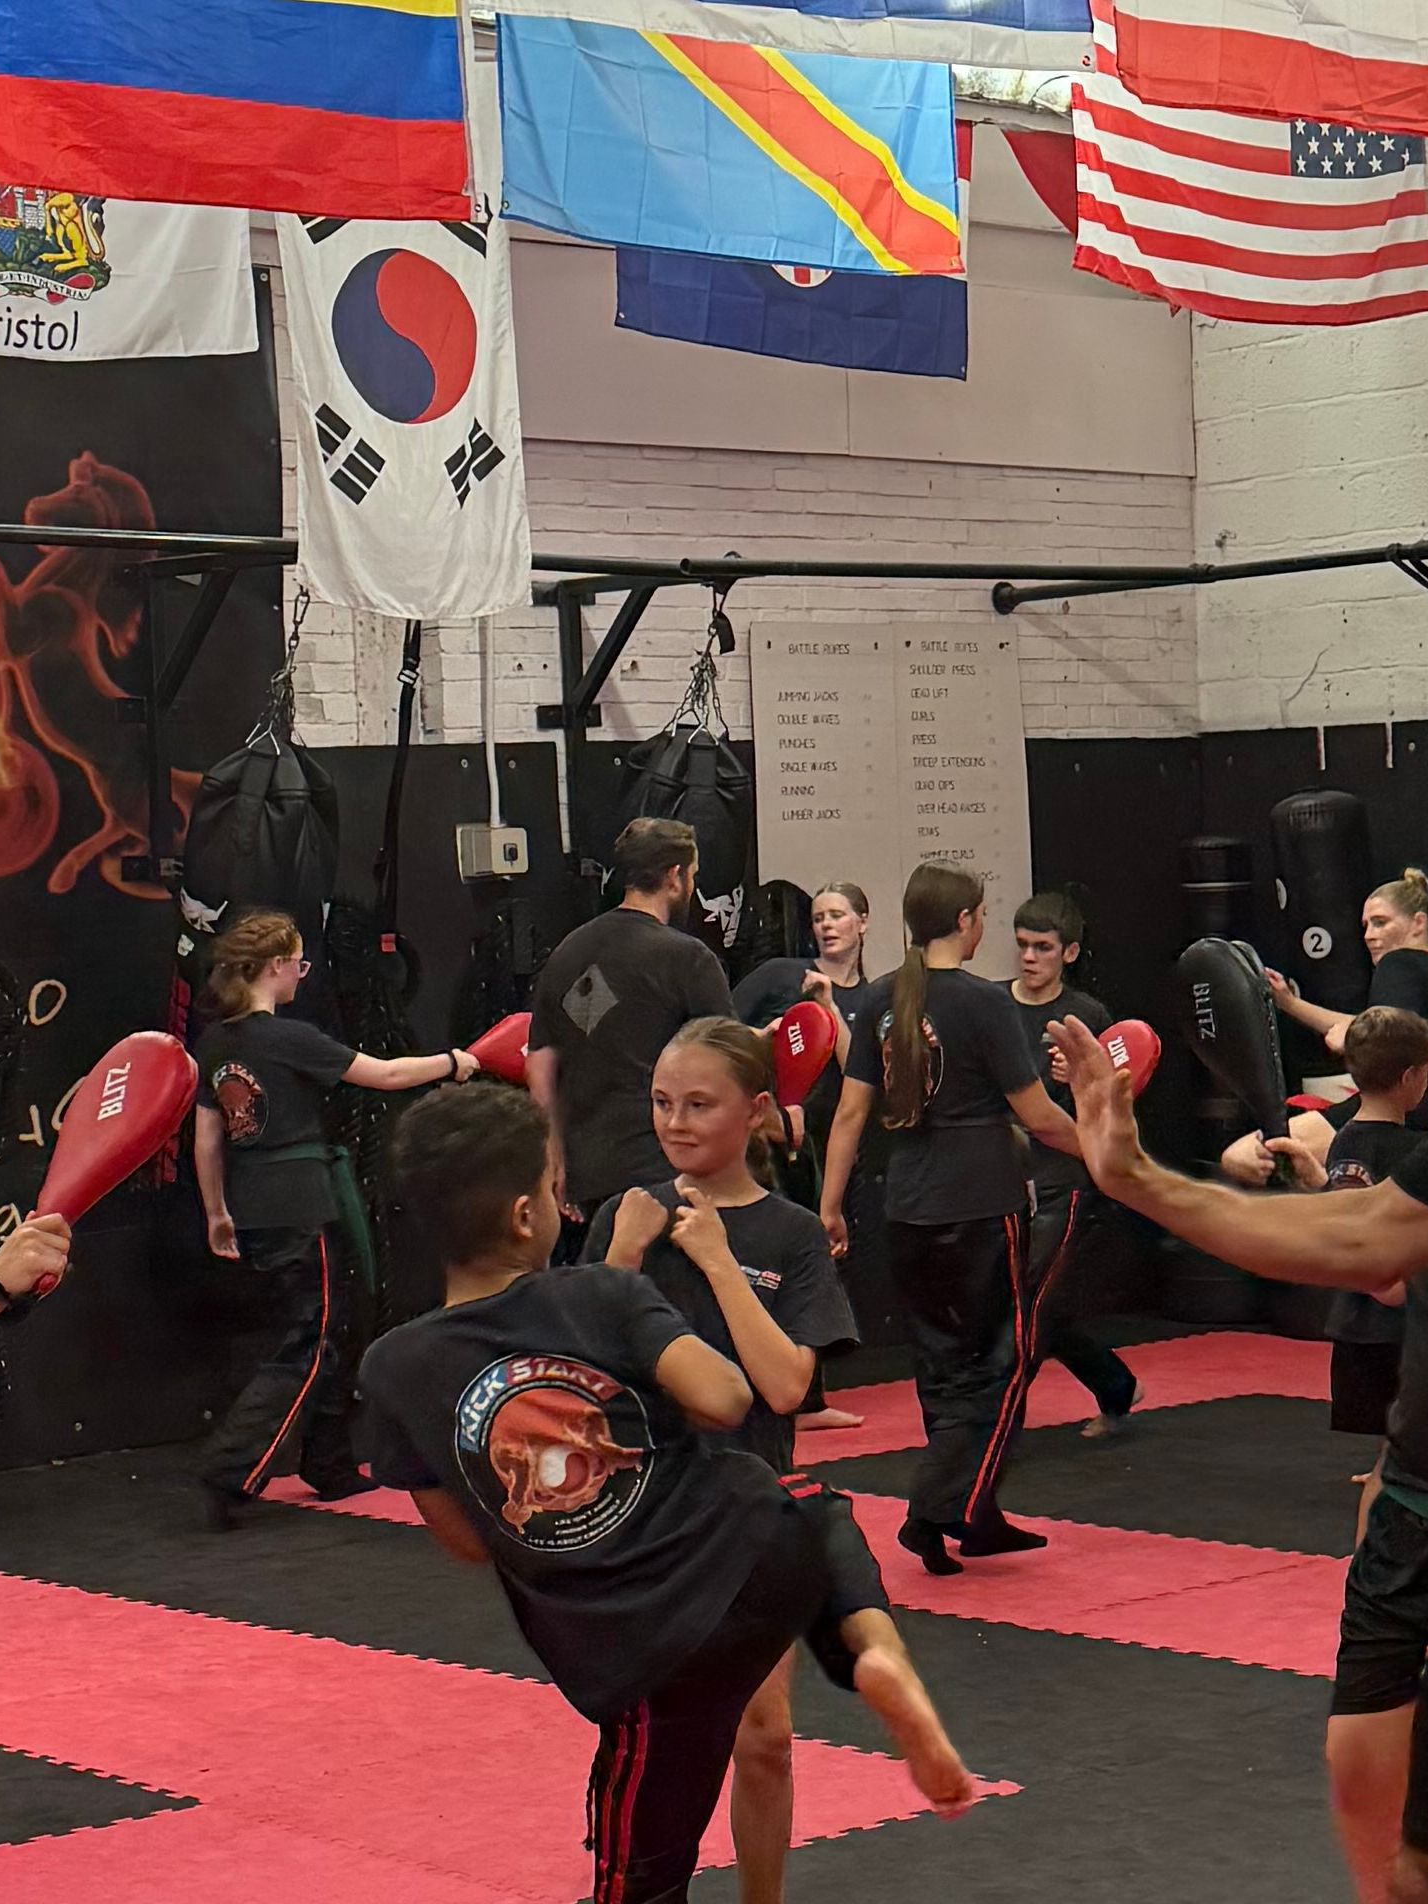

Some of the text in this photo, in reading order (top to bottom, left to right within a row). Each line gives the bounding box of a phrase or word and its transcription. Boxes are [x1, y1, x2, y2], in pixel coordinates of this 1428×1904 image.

[1310, 933, 1324, 953] 2
[1193, 982, 1216, 1039] BLITZ
[788, 1021, 805, 1056] BLITZ
[97, 1062, 131, 1121] BLITZ
